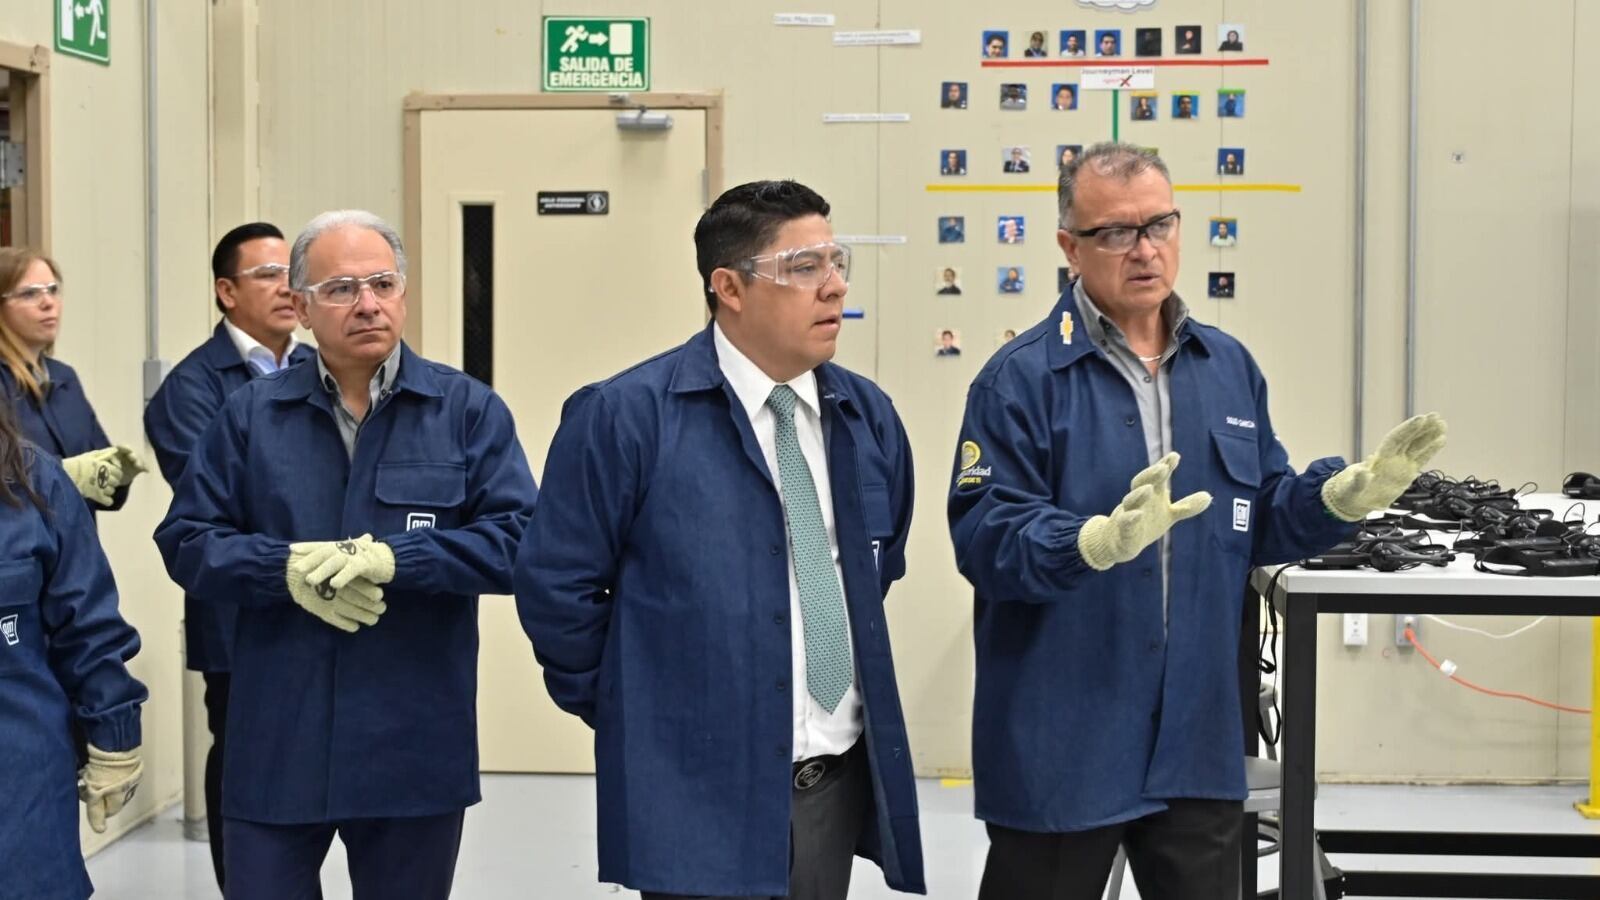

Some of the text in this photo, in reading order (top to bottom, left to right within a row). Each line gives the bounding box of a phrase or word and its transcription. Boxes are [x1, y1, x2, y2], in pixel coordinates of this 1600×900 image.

[559, 57, 634, 72] SALIDA DE
[1081, 67, 1153, 76] Journeyman Level
[549, 72, 643, 87] EMERGENCIA
